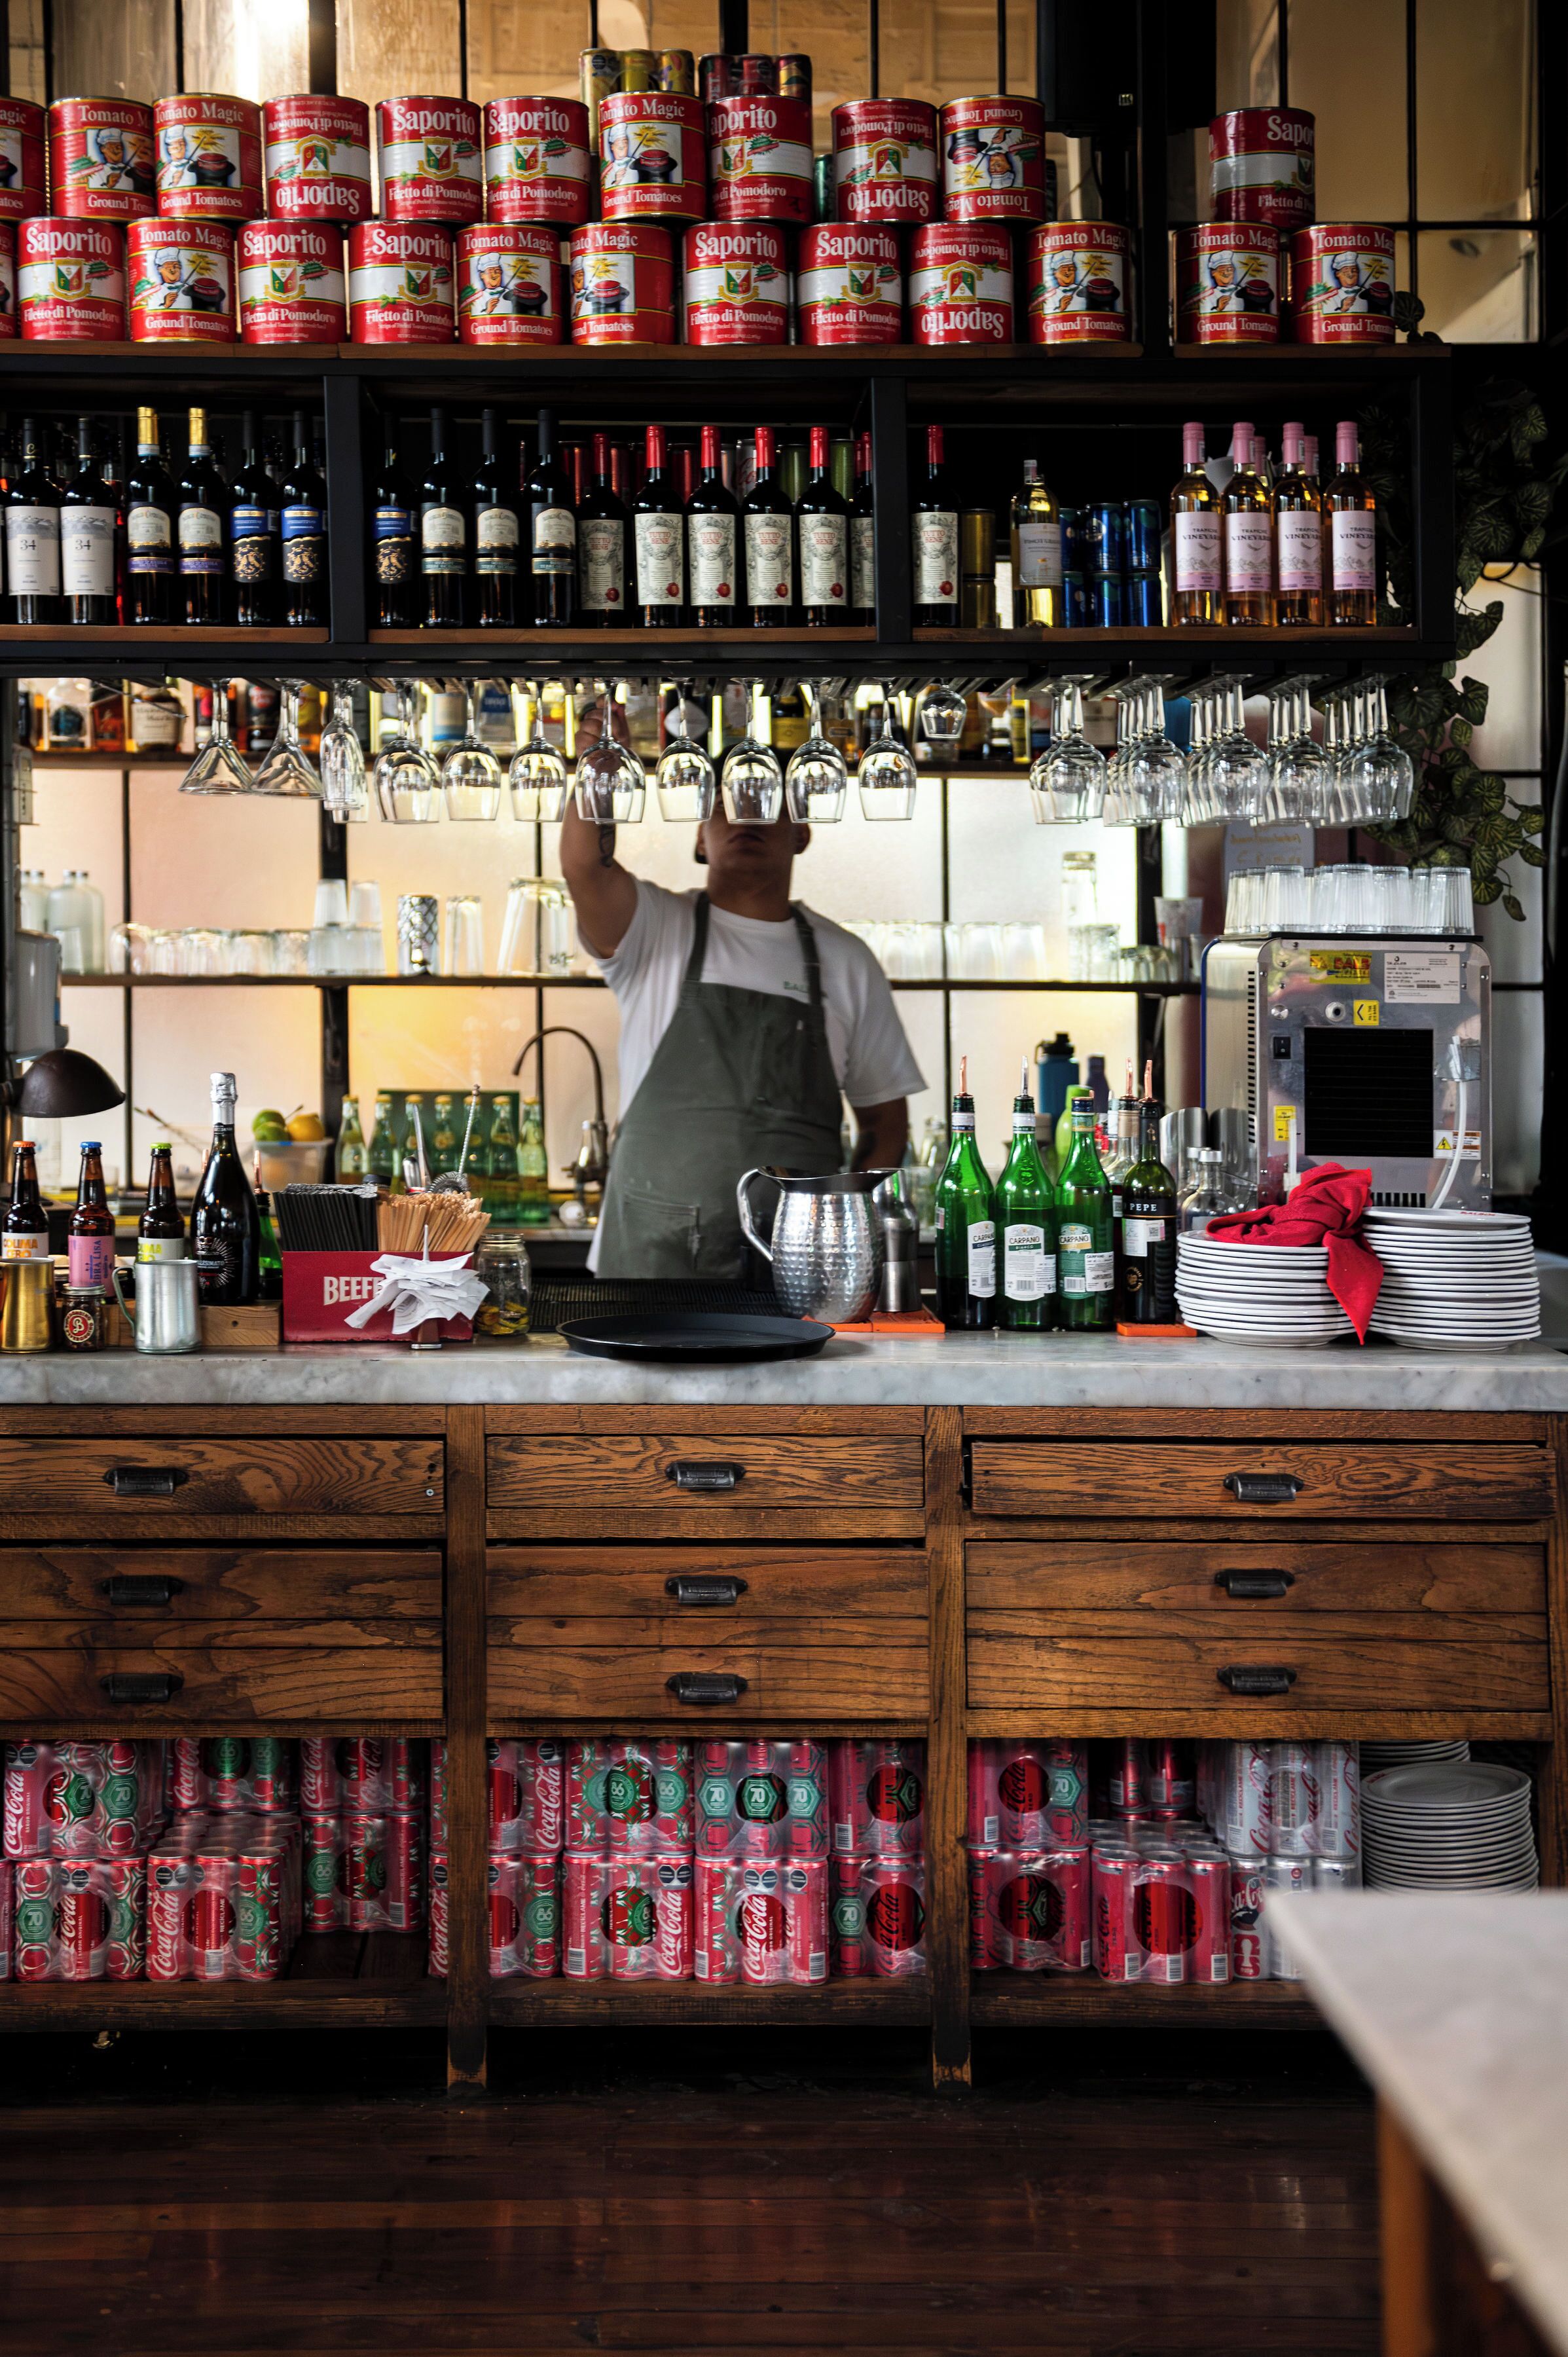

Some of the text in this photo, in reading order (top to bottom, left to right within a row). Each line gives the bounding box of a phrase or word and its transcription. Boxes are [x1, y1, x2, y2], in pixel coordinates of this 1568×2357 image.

[0, 106, 26, 125] agic
[78, 104, 134, 124] Tomato
[156, 106, 196, 124] Tomato
[201, 101, 244, 124] Magic
[392, 104, 476, 136] Saporito
[599, 100, 685, 124] Tomato Magic
[710, 103, 778, 137] aporito
[983, 109, 1023, 122] Ground
[488, 105, 570, 136] Saporito
[275, 181, 360, 215] Saporito
[422, 184, 433, 197] di
[522, 185, 578, 202] Pomodoro
[632, 189, 682, 204] Tomatoes
[730, 183, 787, 198] Pomodoro
[0, 198, 24, 209] atoes
[87, 194, 129, 210] Ground
[193, 192, 244, 208] Tomatoes
[847, 183, 930, 217] Saporito
[977, 195, 1030, 213] Tomato
[1258, 193, 1293, 208] Filetto
[26, 227, 112, 255] Saporito
[137, 227, 192, 244] Tomato
[243, 229, 327, 258] Saporito
[464, 231, 555, 253] Tomato Magic
[594, 230, 638, 250] Magic
[1036, 228, 1125, 249] Tomato Magic
[1190, 230, 1244, 248] Tomato
[1315, 232, 1370, 249] Tomato
[371, 228, 450, 261] Saporito
[694, 231, 778, 259] Saporito
[816, 230, 897, 259] Saporito
[915, 244, 966, 259] Pomodoro
[967, 244, 981, 257] di
[52, 305, 64, 320] di
[268, 307, 336, 323] di Pomodoro
[366, 308, 414, 323] Filetto di
[723, 308, 734, 323] di
[811, 310, 845, 325] Filetto
[845, 308, 857, 322] di
[144, 316, 184, 329] Ground
[470, 320, 553, 337] Ground Tomatoes
[588, 320, 635, 333] Tomatoes
[921, 307, 1004, 338] Saporito
[1042, 317, 1081, 333] Ground
[1197, 318, 1236, 333] Ground
[1321, 317, 1363, 333] Ground
[20, 539, 37, 551] 34
[75, 539, 92, 551] 34
[1129, 1203, 1158, 1211] PEPE
[1009, 1235, 1040, 1244] CARPANO
[1059, 1235, 1089, 1243] CARPANO
[323, 1276, 385, 1306] BEEFE
[1053, 1778, 1069, 1793] 70
[710, 1787, 727, 1802] 70
[750, 1787, 766, 1802] 70
[793, 1787, 808, 1802] 70
[28, 1913, 43, 1928] 70
[843, 1906, 858, 1922] 70
